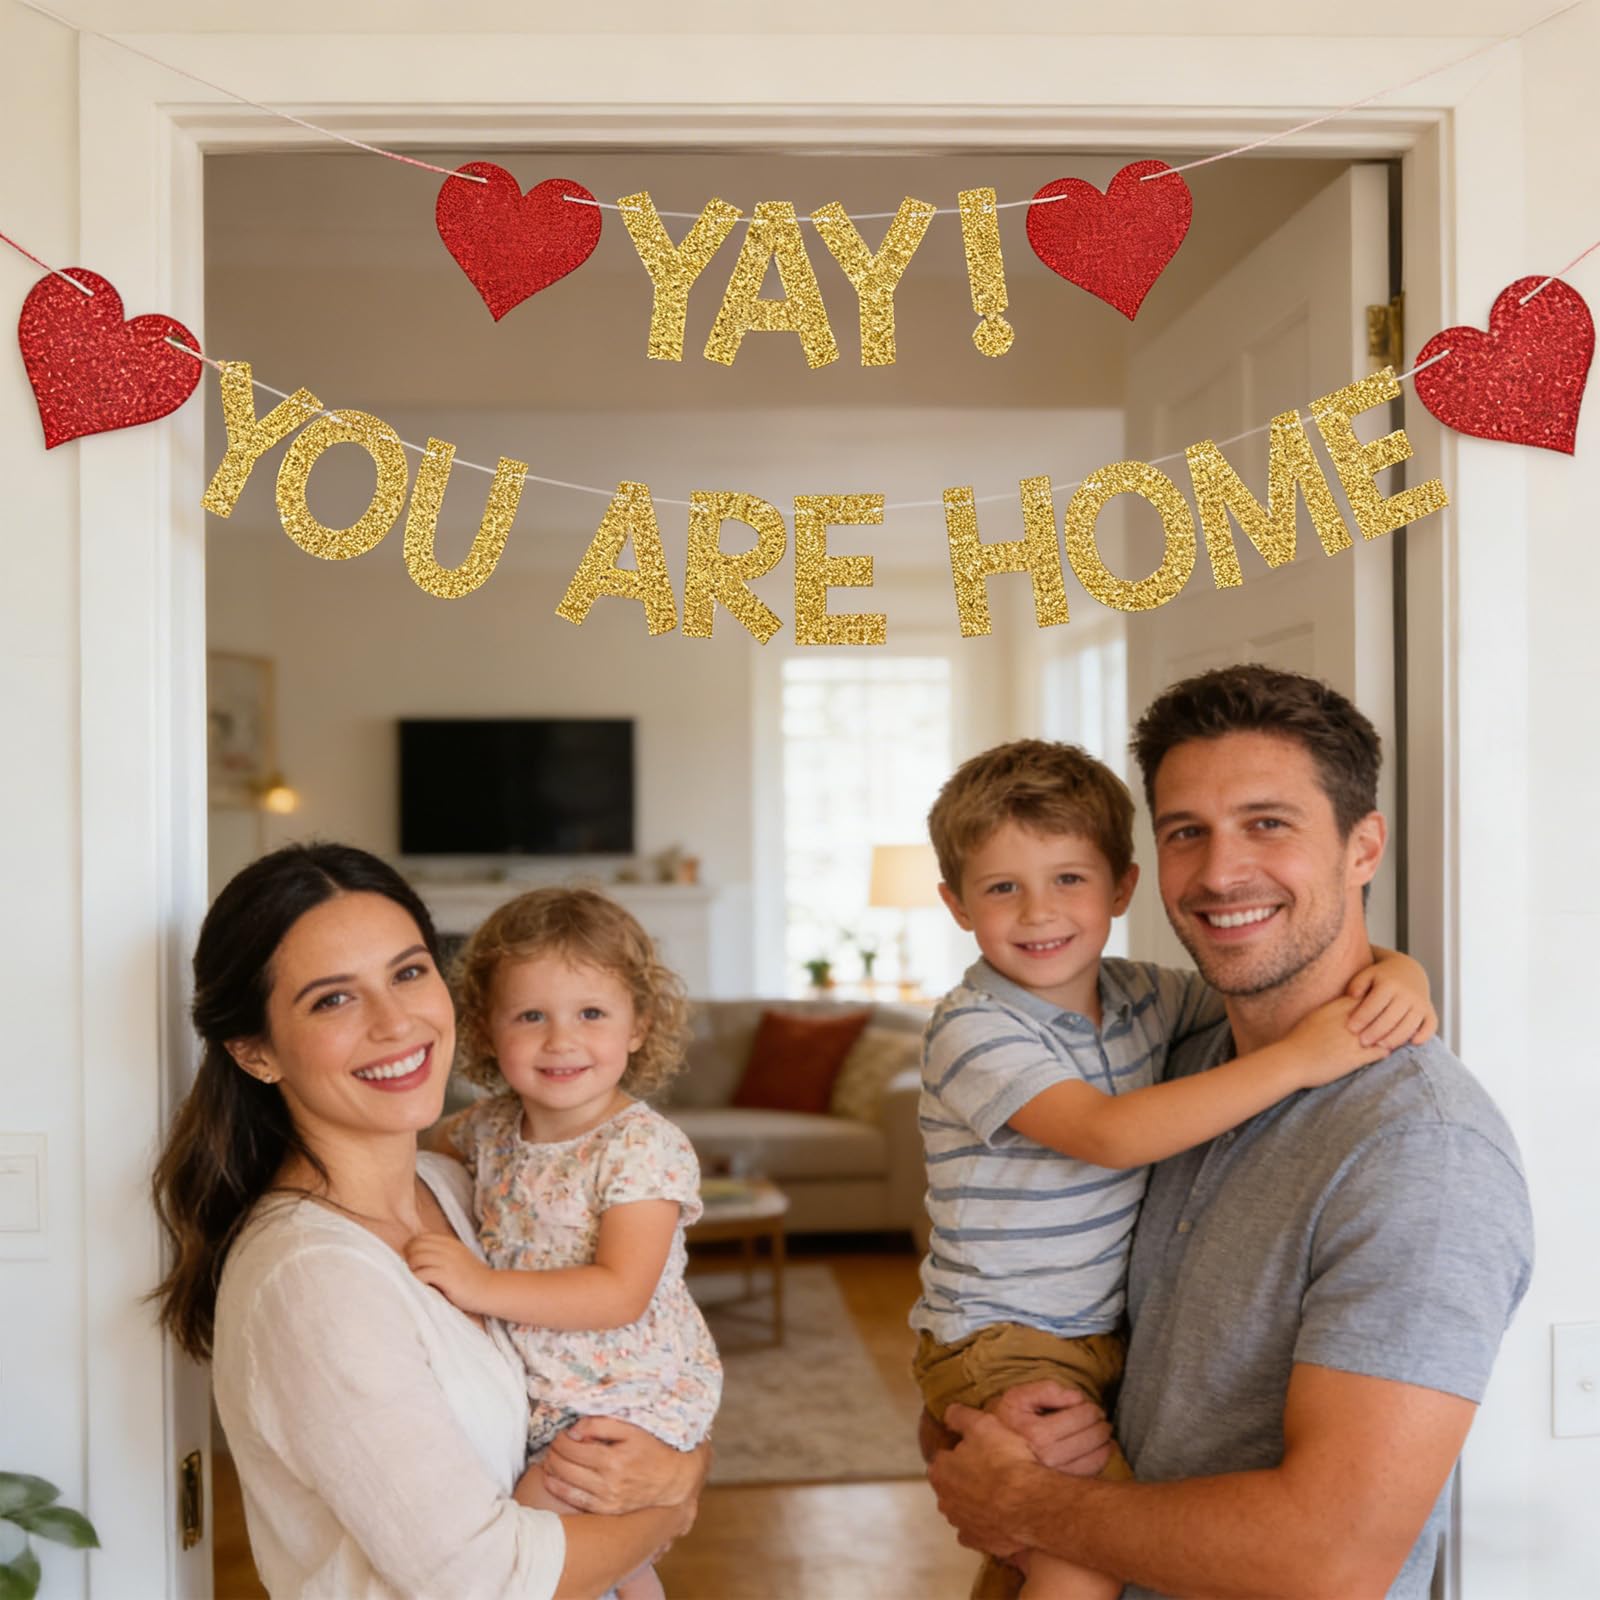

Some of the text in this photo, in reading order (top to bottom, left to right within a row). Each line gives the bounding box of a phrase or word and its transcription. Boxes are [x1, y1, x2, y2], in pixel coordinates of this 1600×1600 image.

[616, 187, 1015, 369] YAY!
[202, 360, 1450, 646] YOU ARE HOME
